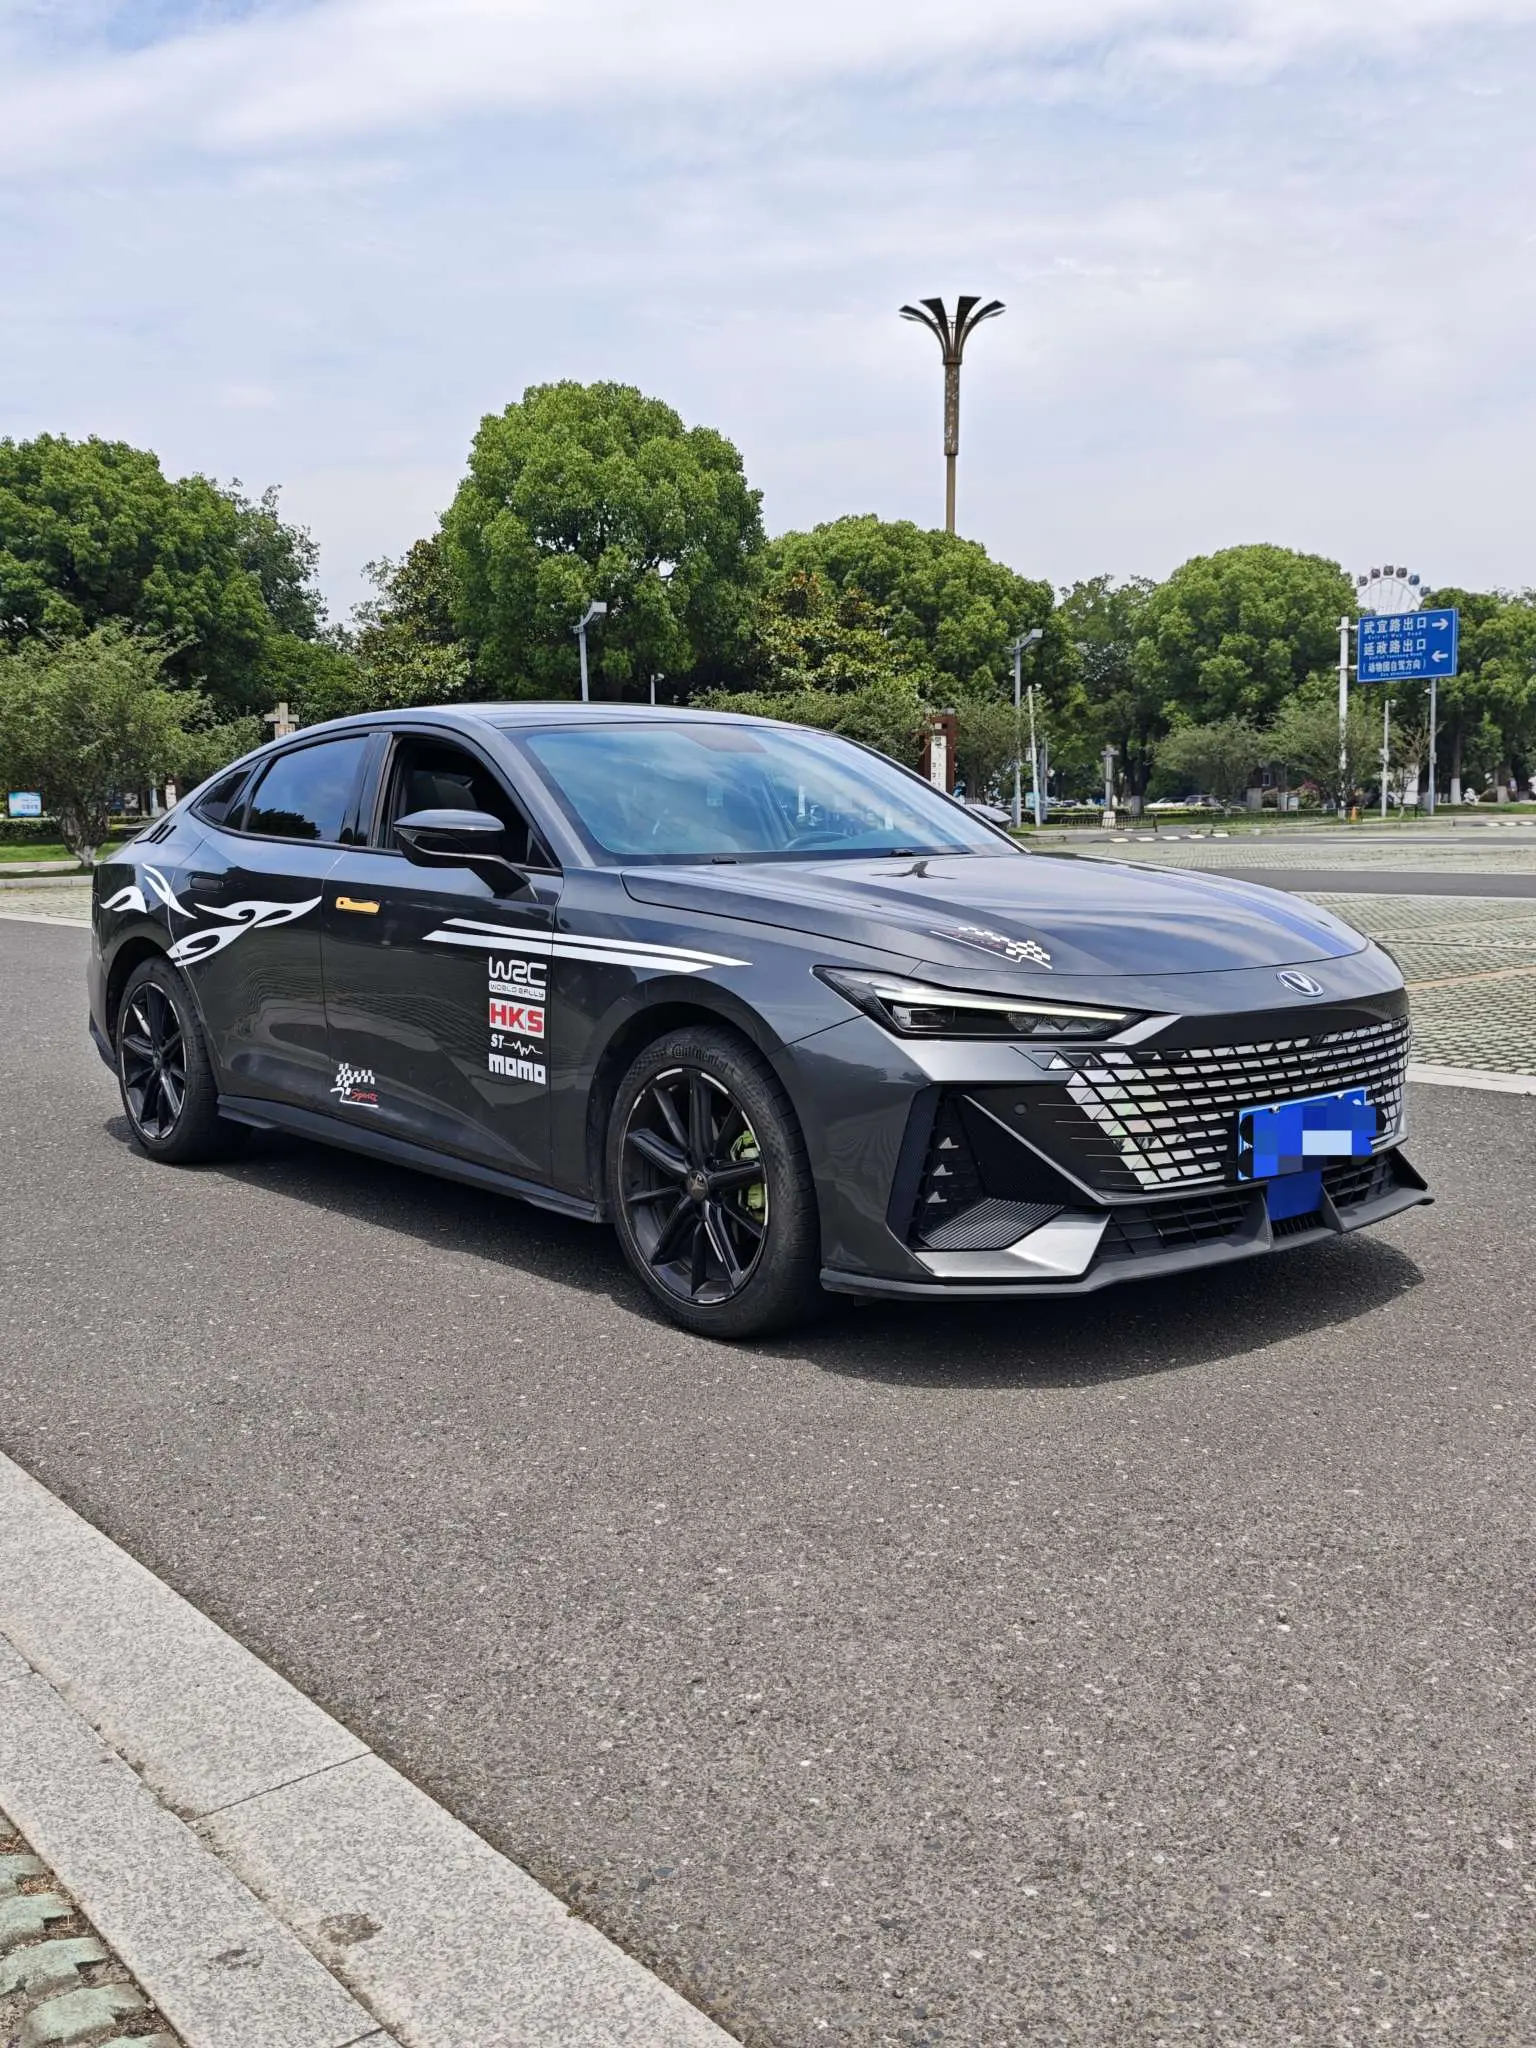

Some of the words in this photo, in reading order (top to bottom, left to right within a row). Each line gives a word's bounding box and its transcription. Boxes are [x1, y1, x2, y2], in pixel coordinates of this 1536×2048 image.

[1364, 617, 1426, 634] 武宜路出口
[1364, 639, 1426, 656] 延政路出口
[489, 956, 547, 987] WRC
[490, 982, 517, 993] WORLD
[490, 1002, 544, 1034] HKS
[491, 1033, 505, 1049] ST
